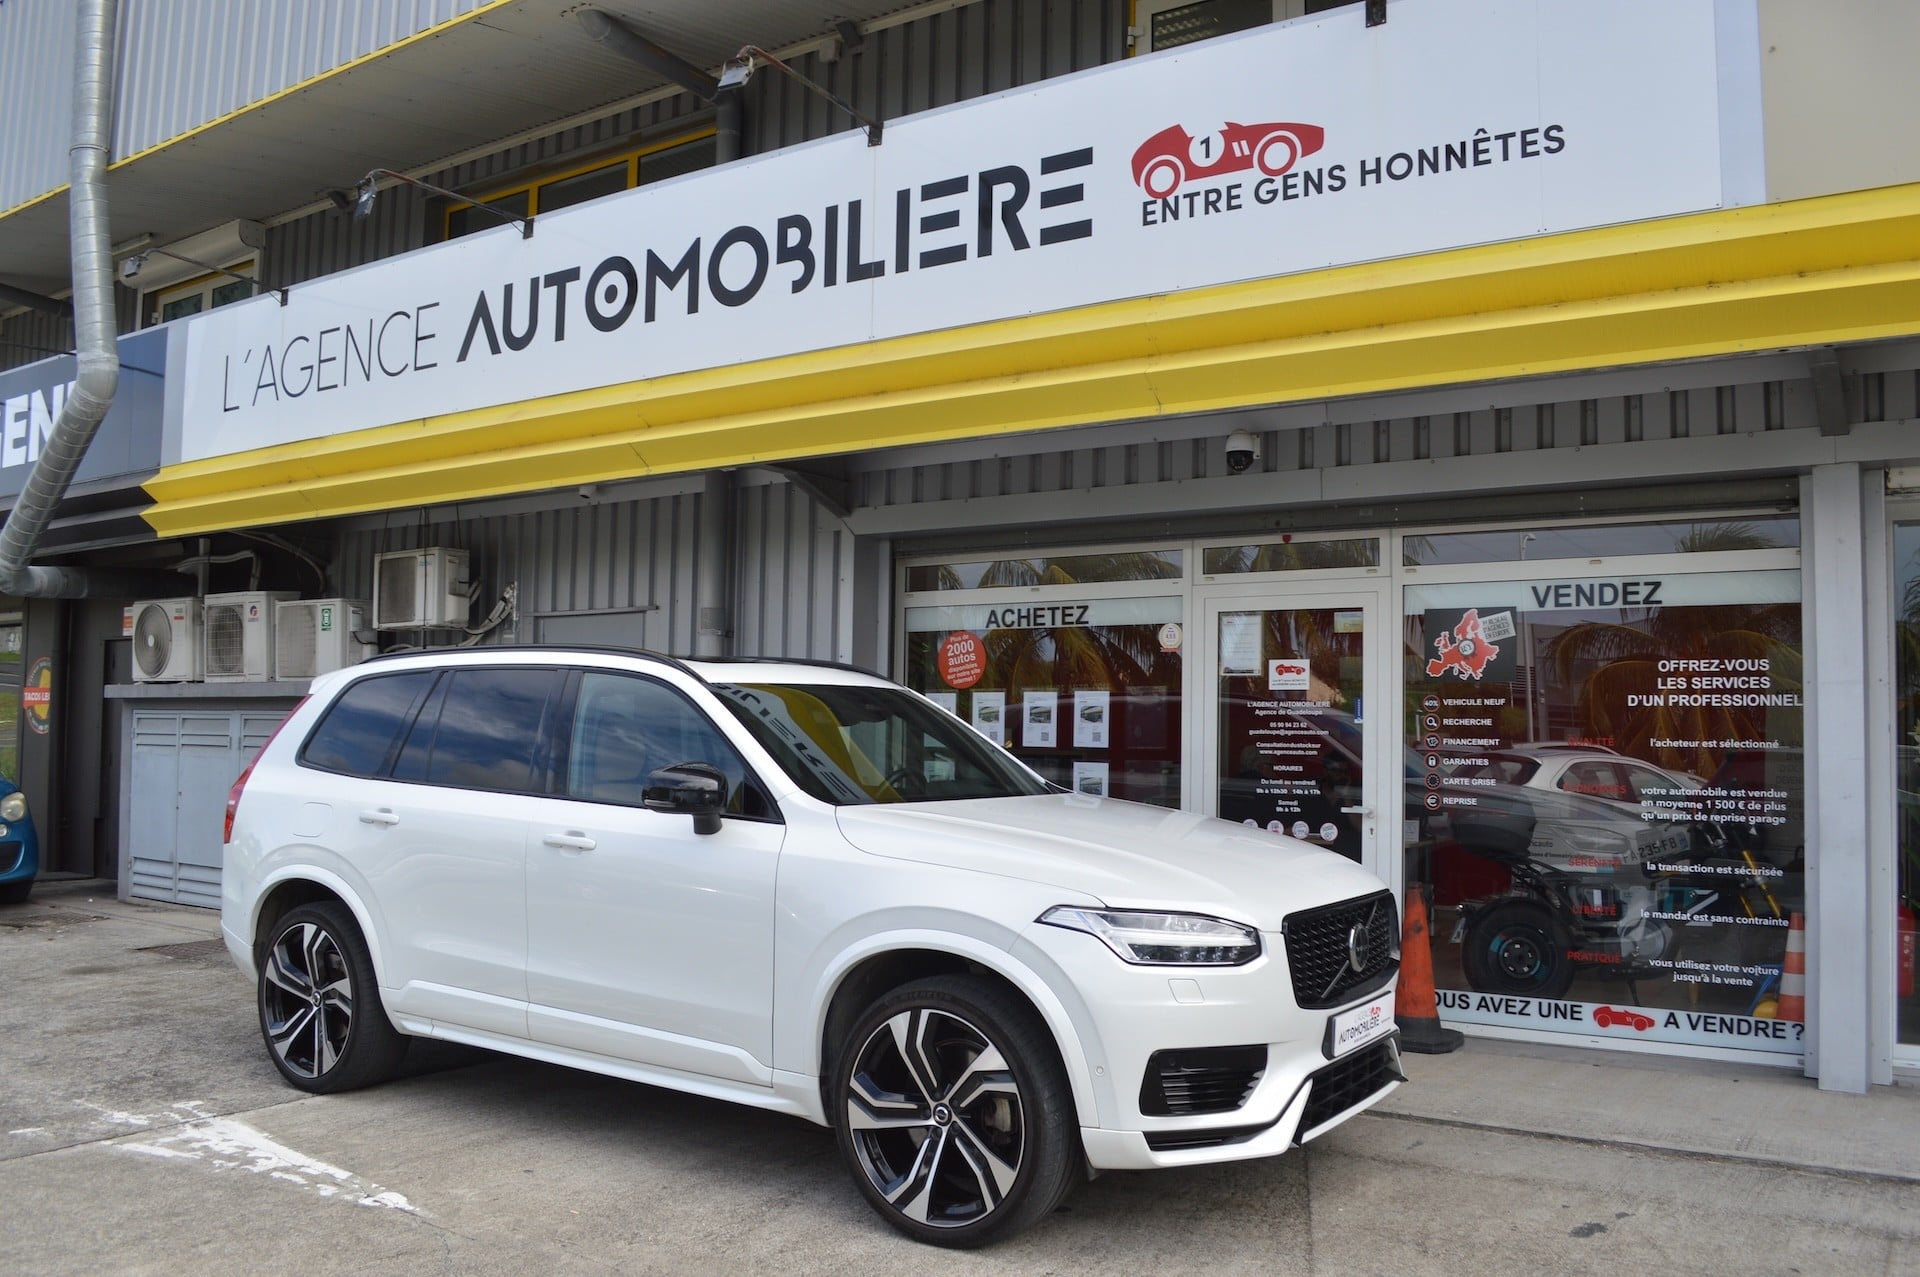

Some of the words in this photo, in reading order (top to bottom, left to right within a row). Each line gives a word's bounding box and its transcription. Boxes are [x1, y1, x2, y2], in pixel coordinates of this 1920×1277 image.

[1199, 136, 1211, 159] 1
[1142, 183, 1243, 227] ENTRE
[1254, 164, 1347, 206] GENS
[1360, 124, 1566, 187] HONNÊTES
[223, 302, 440, 413] L'AGENCE
[456, 146, 1093, 363] AUTOMOBILIERE
[0, 381, 77, 468] EN
[1531, 581, 1662, 608] VENDEZ
[985, 605, 1089, 628] ACHETEZ
[947, 640, 974, 656] 2000
[948, 653, 976, 665] autos
[1658, 659, 1770, 672] OFFREZ-VOUS
[1657, 677, 1687, 690] LES
[1691, 676, 1771, 689] SERVICES
[1484, 698, 1506, 706] NEUF
[1627, 694, 1665, 707] D'UN
[1668, 694, 1803, 707] PROFESSIONNEL
[1443, 718, 1493, 726] RECHERCHE
[1443, 738, 1500, 746] FINANCEMENT
[1650, 738, 1700, 748] l'acheteur
[1702, 739, 1718, 748] est
[1719, 738, 1780, 749] sélectionné
[1443, 758, 1489, 766] GARANTIES
[1471, 778, 1497, 786] GRISE
[1641, 787, 1667, 795] votre
[1669, 787, 1728, 797] automobile
[1730, 789, 1746, 797] est
[1748, 788, 1788, 798] vendue
[1443, 797, 1478, 805] REPRISE
[1656, 800, 1703, 810] moyenne
[1715, 800, 1736, 810] 500
[1738, 801, 1746, 810] €
[1747, 801, 1762, 810] de
[1764, 801, 1787, 812] plus
[1641, 812, 1670, 821] qu'un
[1672, 812, 1693, 821] prix
[1694, 812, 1709, 821] de
[1710, 813, 1746, 823] reprise
[1748, 815, 1786, 825] garage
[1647, 861, 1656, 871] la
[1658, 863, 1714, 874] transaction
[1717, 865, 1733, 874] est
[1735, 865, 1784, 876] sécurisée
[1641, 909, 1650, 918] le
[1652, 910, 1691, 920] mandat
[1693, 913, 1709, 922] est
[1710, 915, 1734, 924] sans
[1736, 915, 1789, 927] contrainte
[1568, 951, 1622, 964] PRATIQUE
[1649, 960, 1673, 968] vous
[1675, 960, 1710, 971] utilisez
[1713, 964, 1740, 973] votre
[1742, 965, 1780, 976] voiture
[1673, 972, 1709, 984] jusqu'à
[1712, 973, 1722, 983] la
[1724, 976, 1754, 987] vente
[1434, 991, 1470, 1009] US
[1476, 996, 1531, 1016] AVEZ
[1538, 1001, 1583, 1021] UNE
[1664, 1012, 1680, 1029] A
[1686, 1013, 1787, 1039] VENDRE
